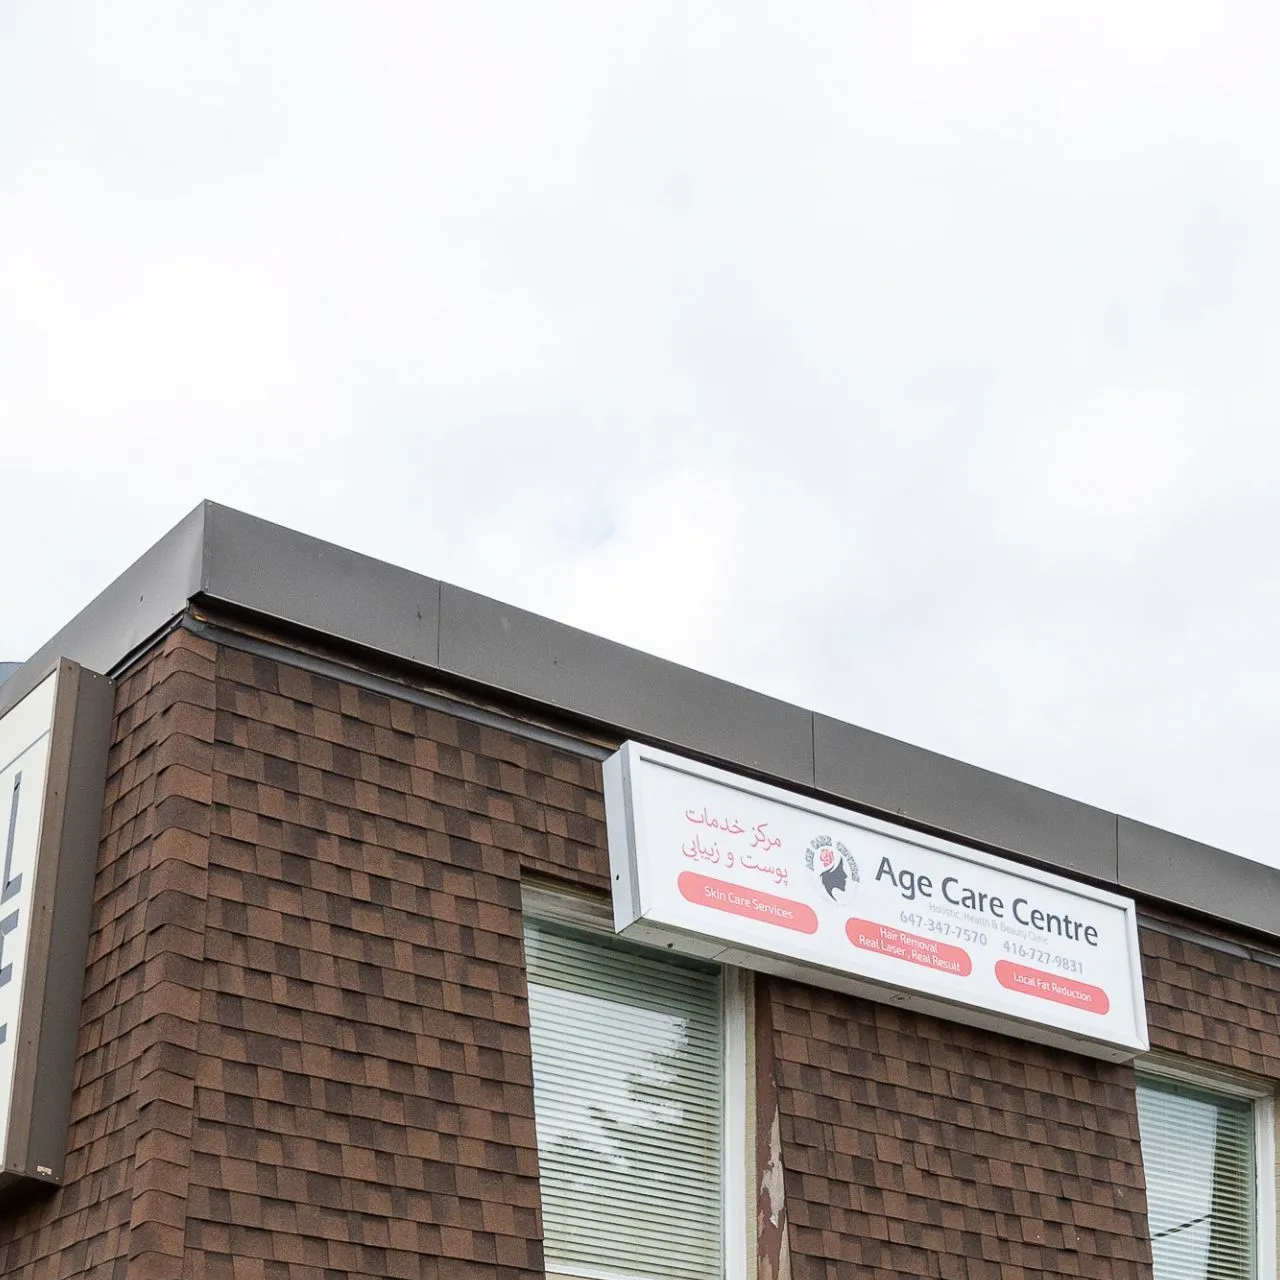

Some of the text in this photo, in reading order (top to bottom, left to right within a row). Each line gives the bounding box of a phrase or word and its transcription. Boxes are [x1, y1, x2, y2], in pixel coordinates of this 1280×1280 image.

[685, 807, 745, 834] خدمات
[704, 885, 794, 920] Skin Care Services
[875, 856, 1098, 947] Age Care Centre
[900, 910, 987, 946] 647-347-7570
[964, 911, 990, 928] Health
[991, 919, 999, 930] &
[859, 934, 880, 949] Real
[881, 941, 907, 955] Laser
[911, 949, 932, 963] Real
[932, 956, 961, 971] Result
[880, 927, 939, 953] Hair Removal
[1003, 940, 1083, 975] 416-727-9831
[1013, 971, 1093, 1002] Local Fat Reduction
